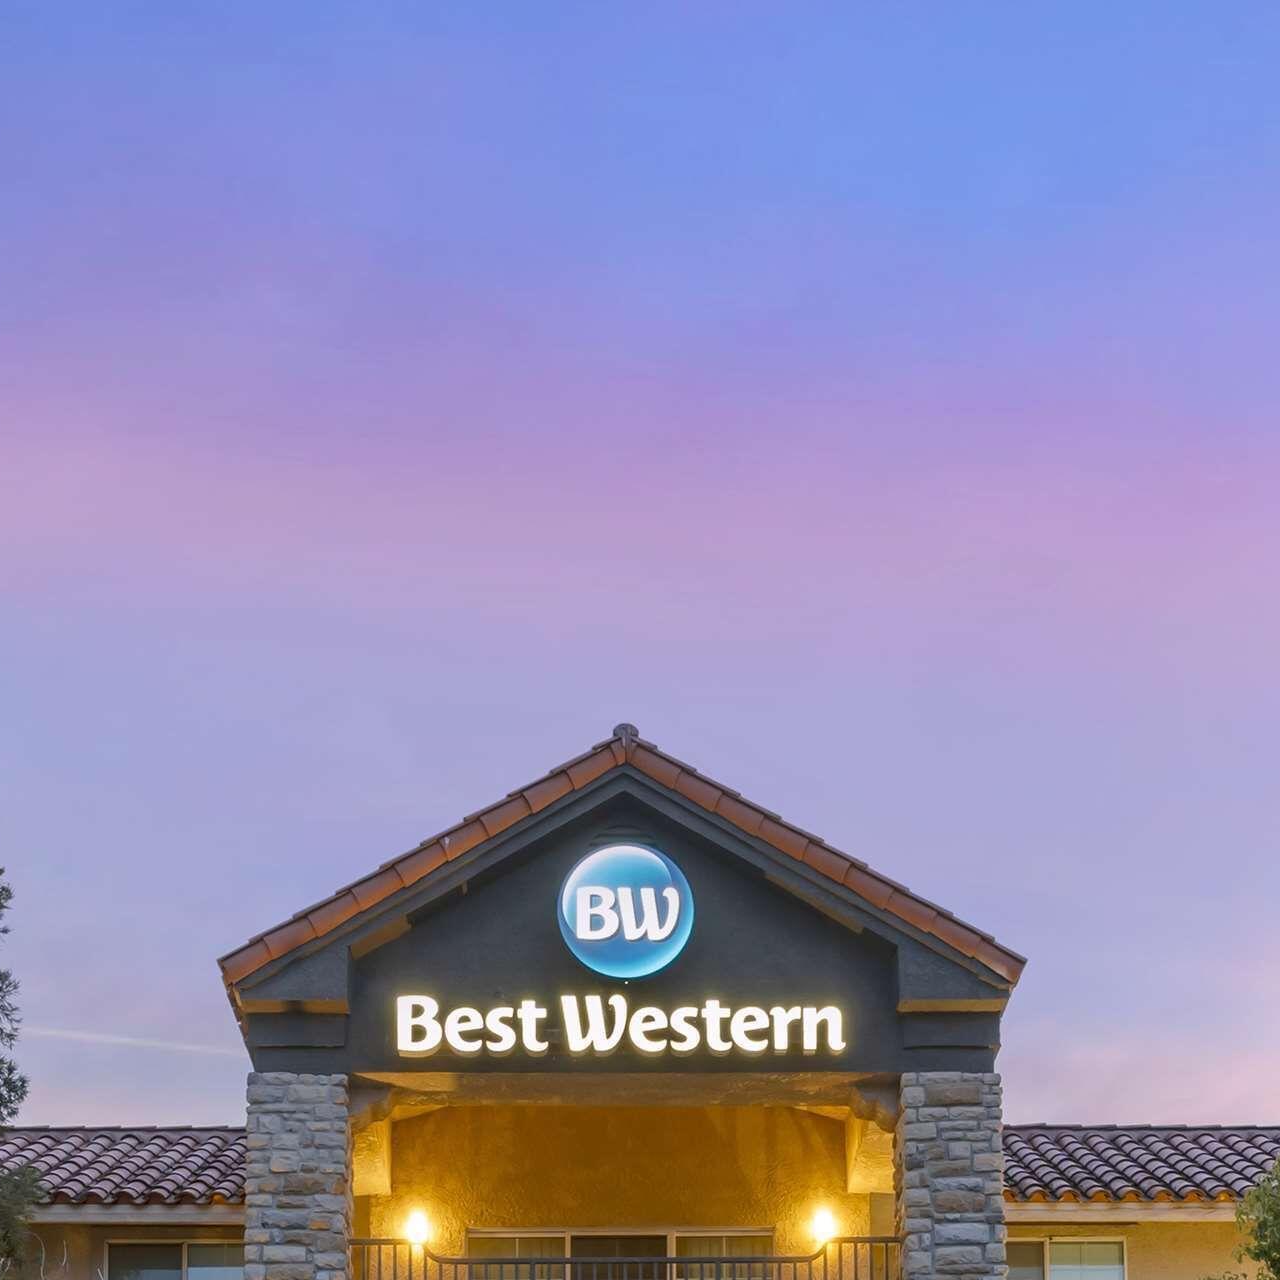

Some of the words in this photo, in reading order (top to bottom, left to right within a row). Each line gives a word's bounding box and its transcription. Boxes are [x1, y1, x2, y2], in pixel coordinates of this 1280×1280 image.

[575, 886, 680, 941] BW
[395, 995, 548, 1053] Best
[561, 994, 846, 1053] Western
